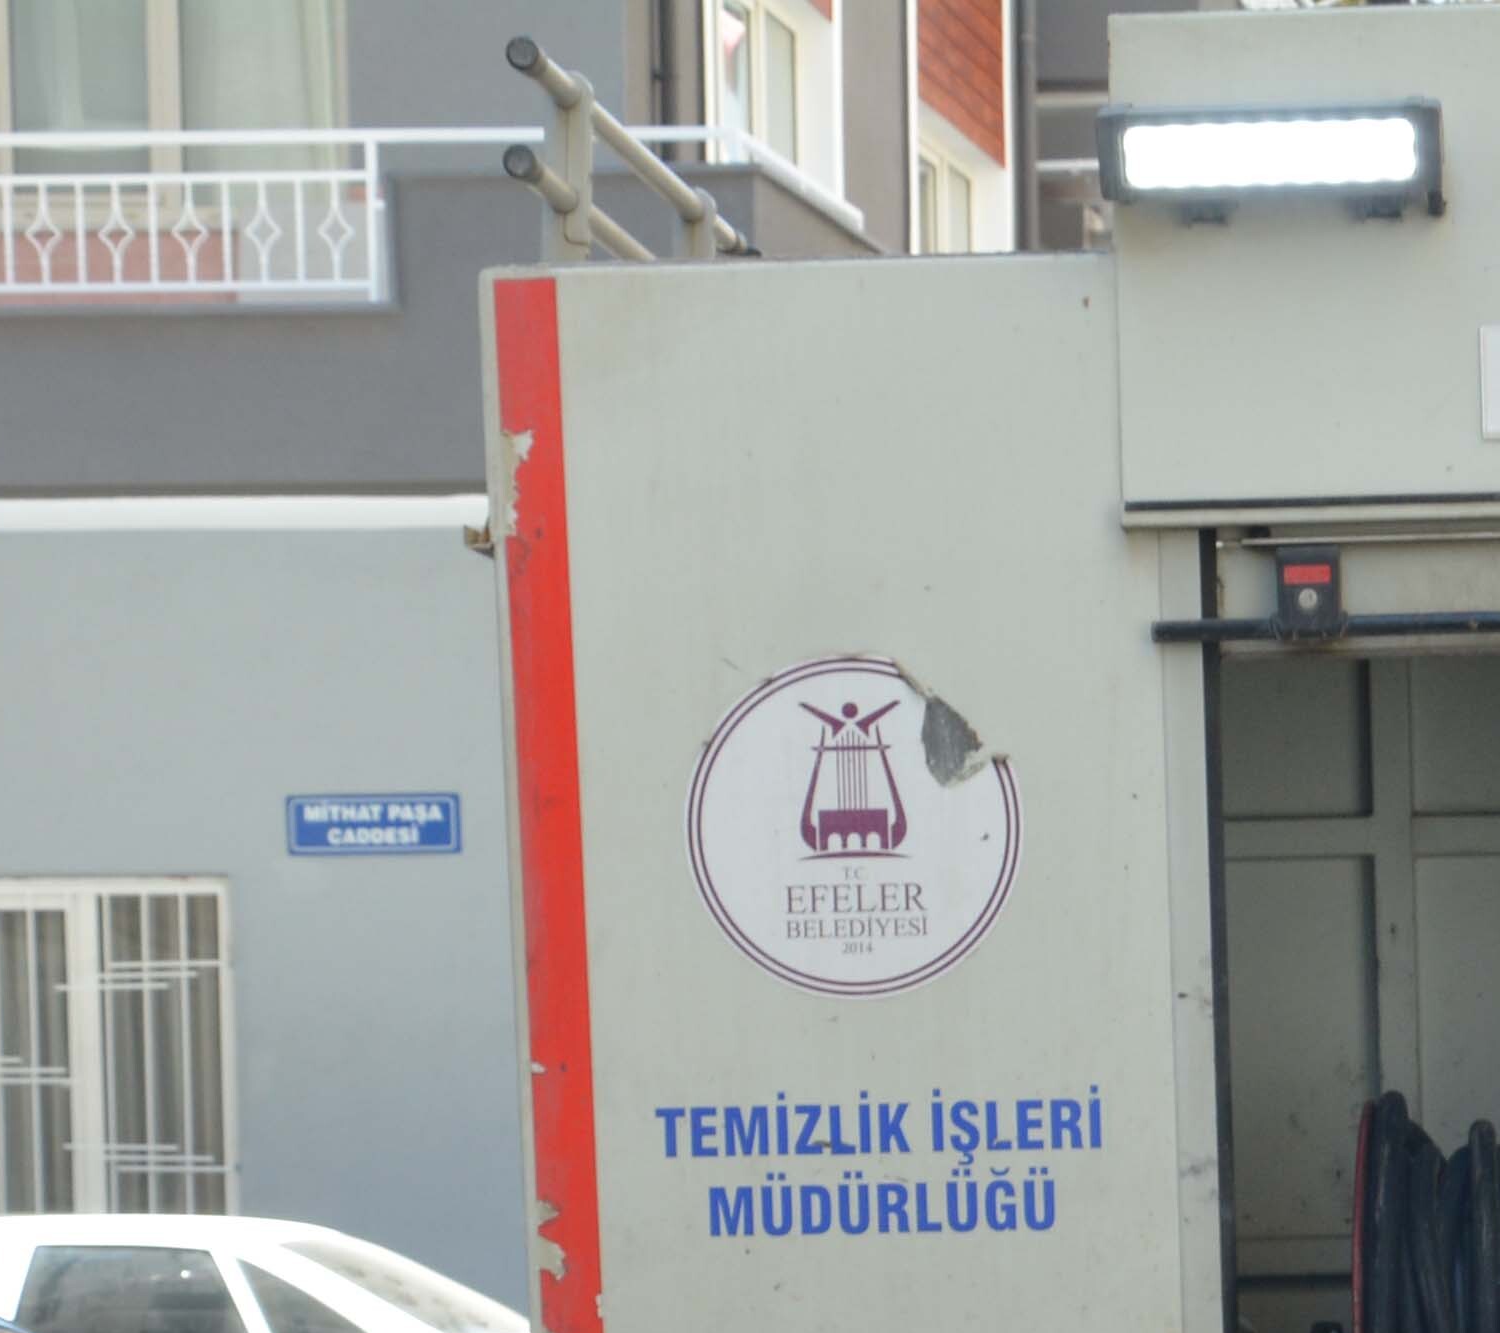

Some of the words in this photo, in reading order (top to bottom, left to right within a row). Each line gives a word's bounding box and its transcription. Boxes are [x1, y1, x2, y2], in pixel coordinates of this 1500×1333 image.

[303, 801, 383, 822] MİTHAT
[387, 803, 443, 825] PAŞA
[326, 823, 420, 844] CADDESİ
[785, 882, 928, 914] EFELER
[786, 915, 929, 939] BELEDİYESİ
[842, 942, 873, 954] 2014
[655, 1091, 910, 1158] TEMİZLİK
[930, 1085, 1103, 1166] İŞLERİ
[708, 1167, 1056, 1237] MÜDÜRLÜĞÜ
